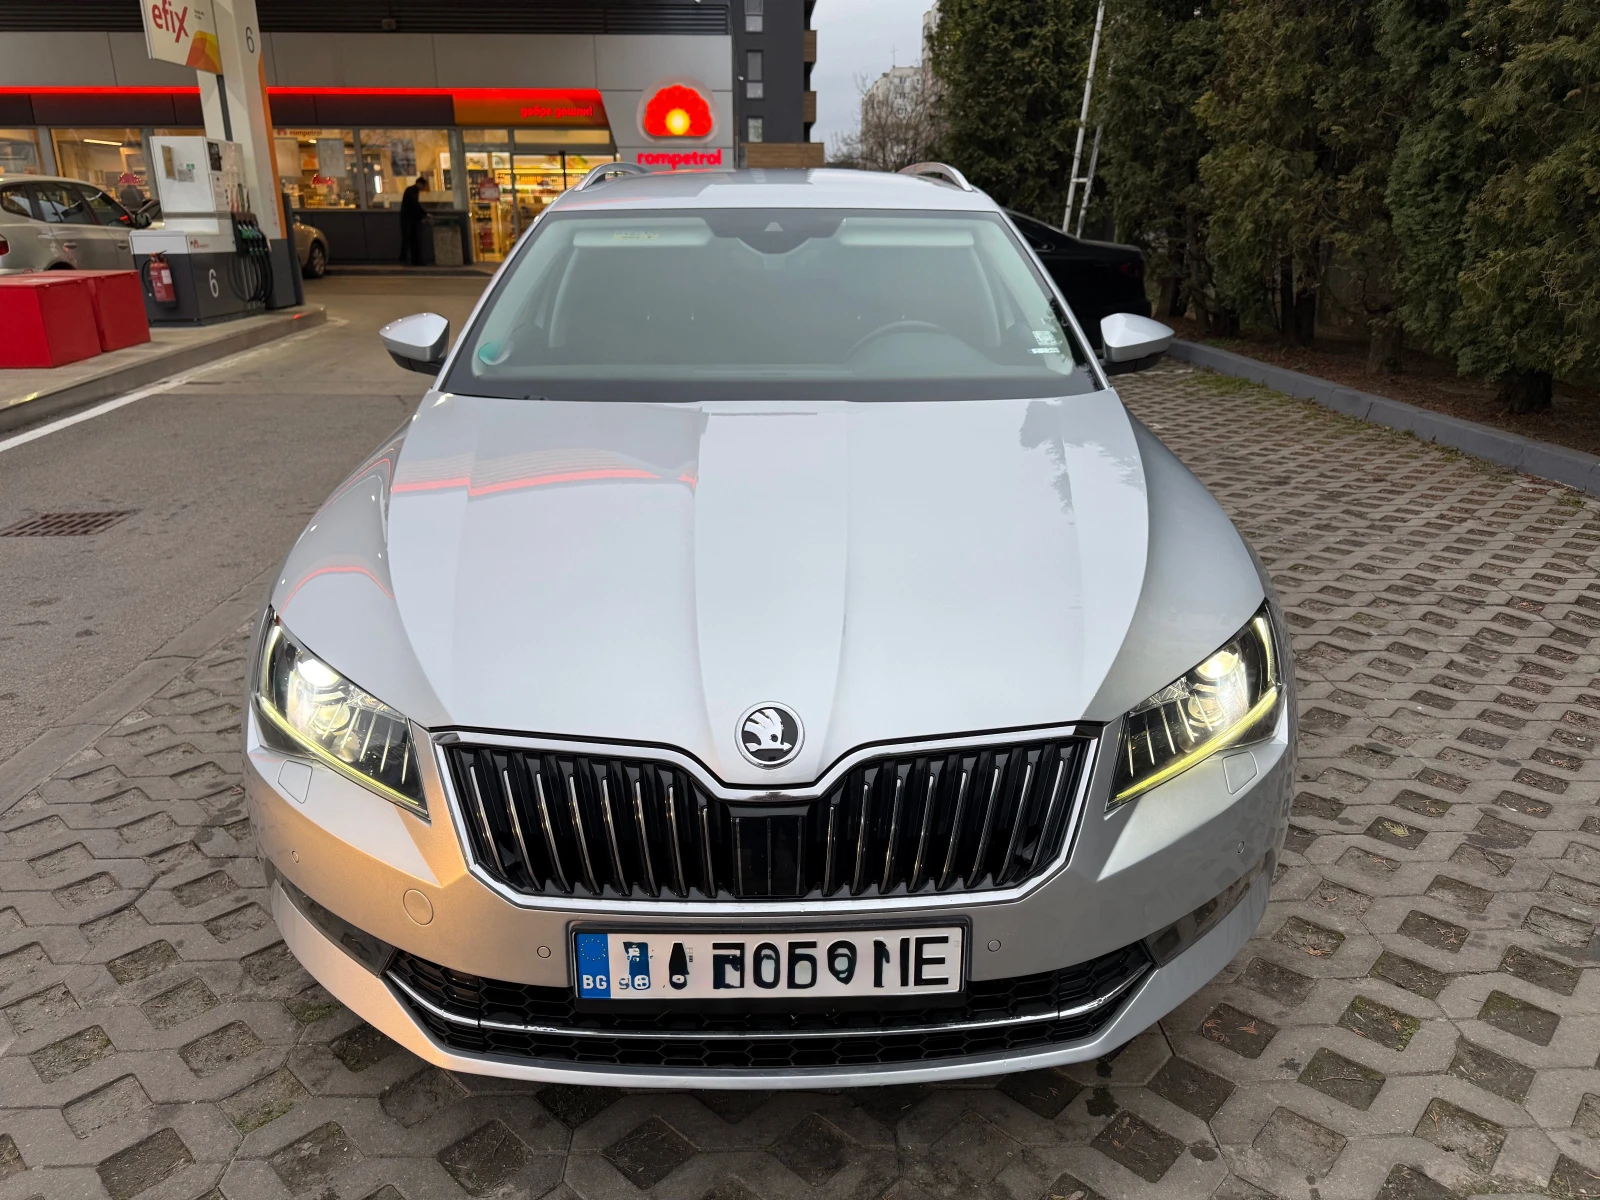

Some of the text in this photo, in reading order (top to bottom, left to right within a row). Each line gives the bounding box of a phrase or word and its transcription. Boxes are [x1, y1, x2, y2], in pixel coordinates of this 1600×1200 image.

[151, 0, 190, 44] efix
[245, 26, 255, 54] 6
[637, 148, 722, 171] rompetrol
[208, 268, 219, 298] 6
[582, 974, 607, 990] BG
